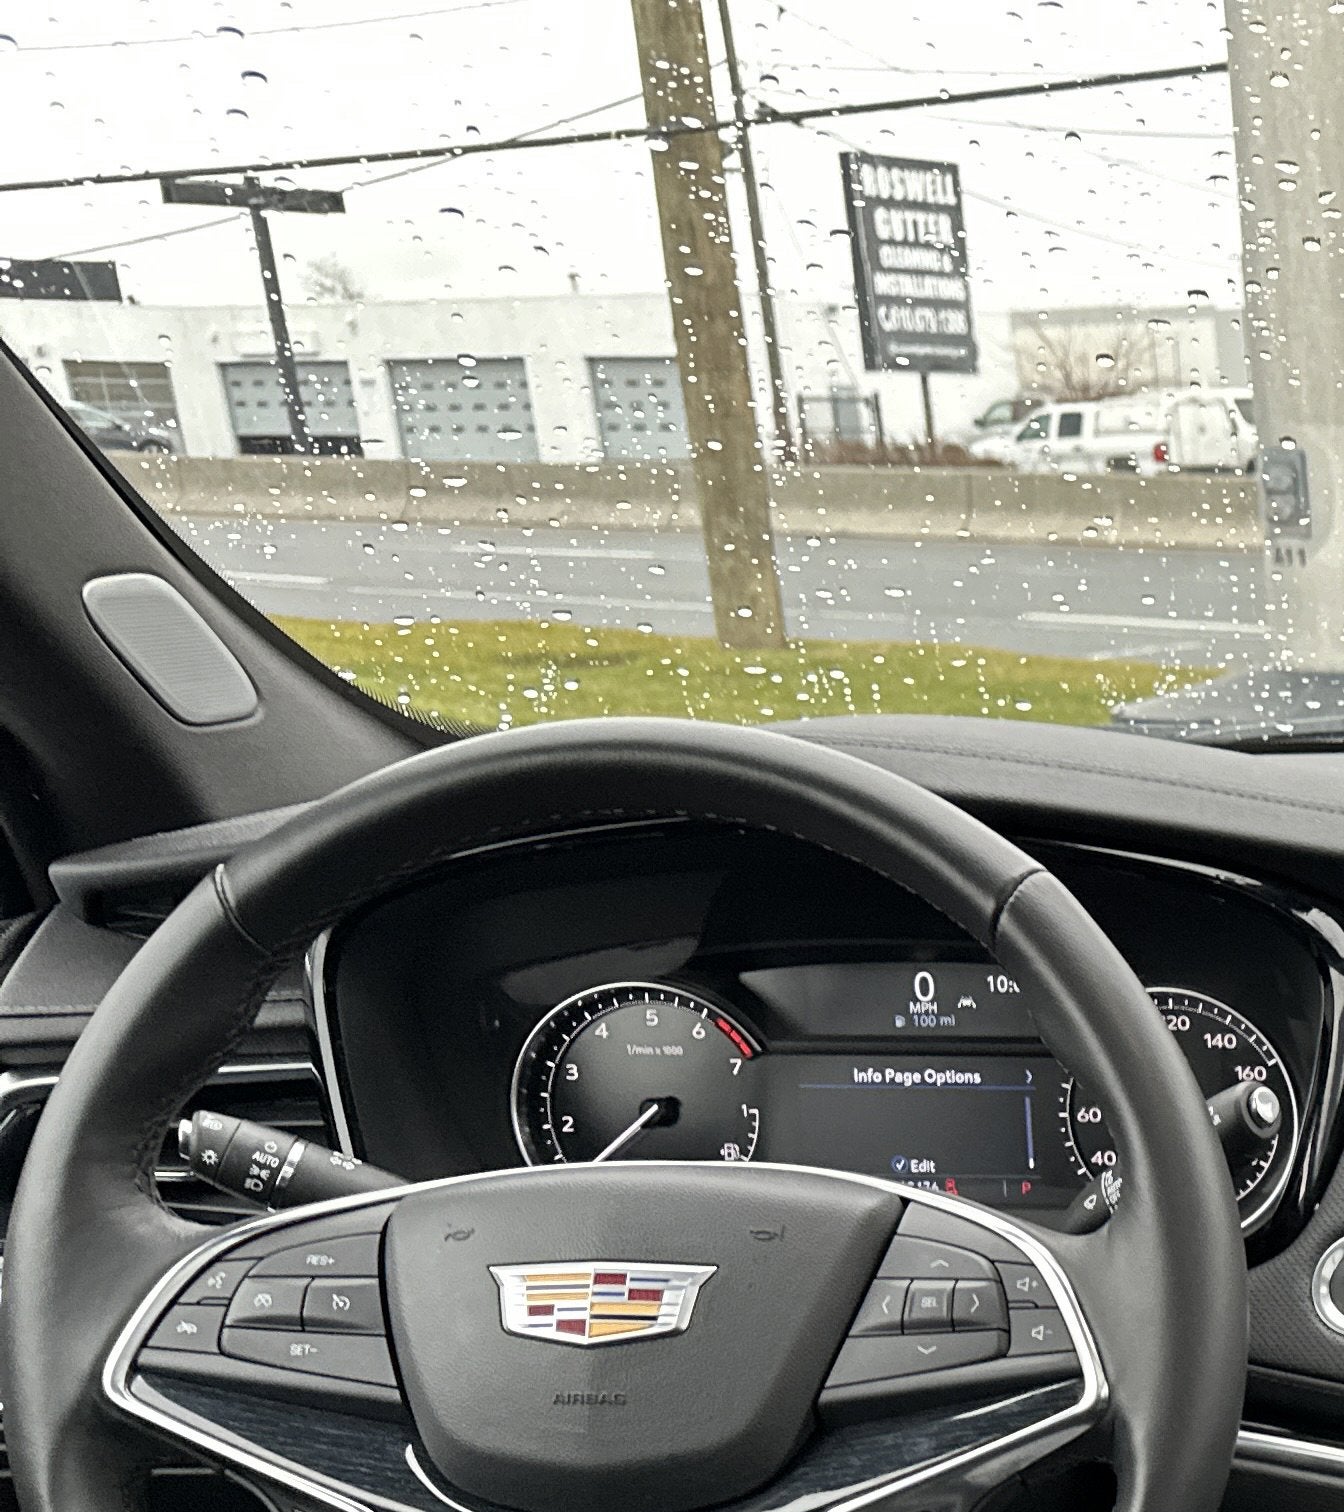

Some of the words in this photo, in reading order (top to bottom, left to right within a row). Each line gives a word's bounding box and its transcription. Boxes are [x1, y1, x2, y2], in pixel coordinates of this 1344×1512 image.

[914, 971, 935, 1001] 0
[909, 1001, 938, 1014] MPH
[645, 1009, 659, 1027] 5
[912, 1015, 937, 1027] 100
[939, 1014, 956, 1026] mi
[1162, 1015, 1191, 1031] 20
[594, 1022, 609, 1039] 4
[692, 1022, 706, 1040] 6
[1203, 1033, 1237, 1049] 140
[565, 1063, 579, 1081] 3
[729, 1057, 742, 1075] 7
[1234, 1065, 1267, 1081] 160
[853, 1068, 882, 1083] Info
[885, 1068, 922, 1086] Page
[924, 1068, 982, 1086] Options
[1077, 1107, 1102, 1123] 60
[561, 1115, 575, 1132] 2
[251, 1150, 280, 1168] AUTO
[910, 1159, 936, 1173] Edit
[1091, 1150, 1117, 1166] 40
[1021, 1180, 1032, 1195] P
[553, 1392, 627, 1406] AIRBAG
